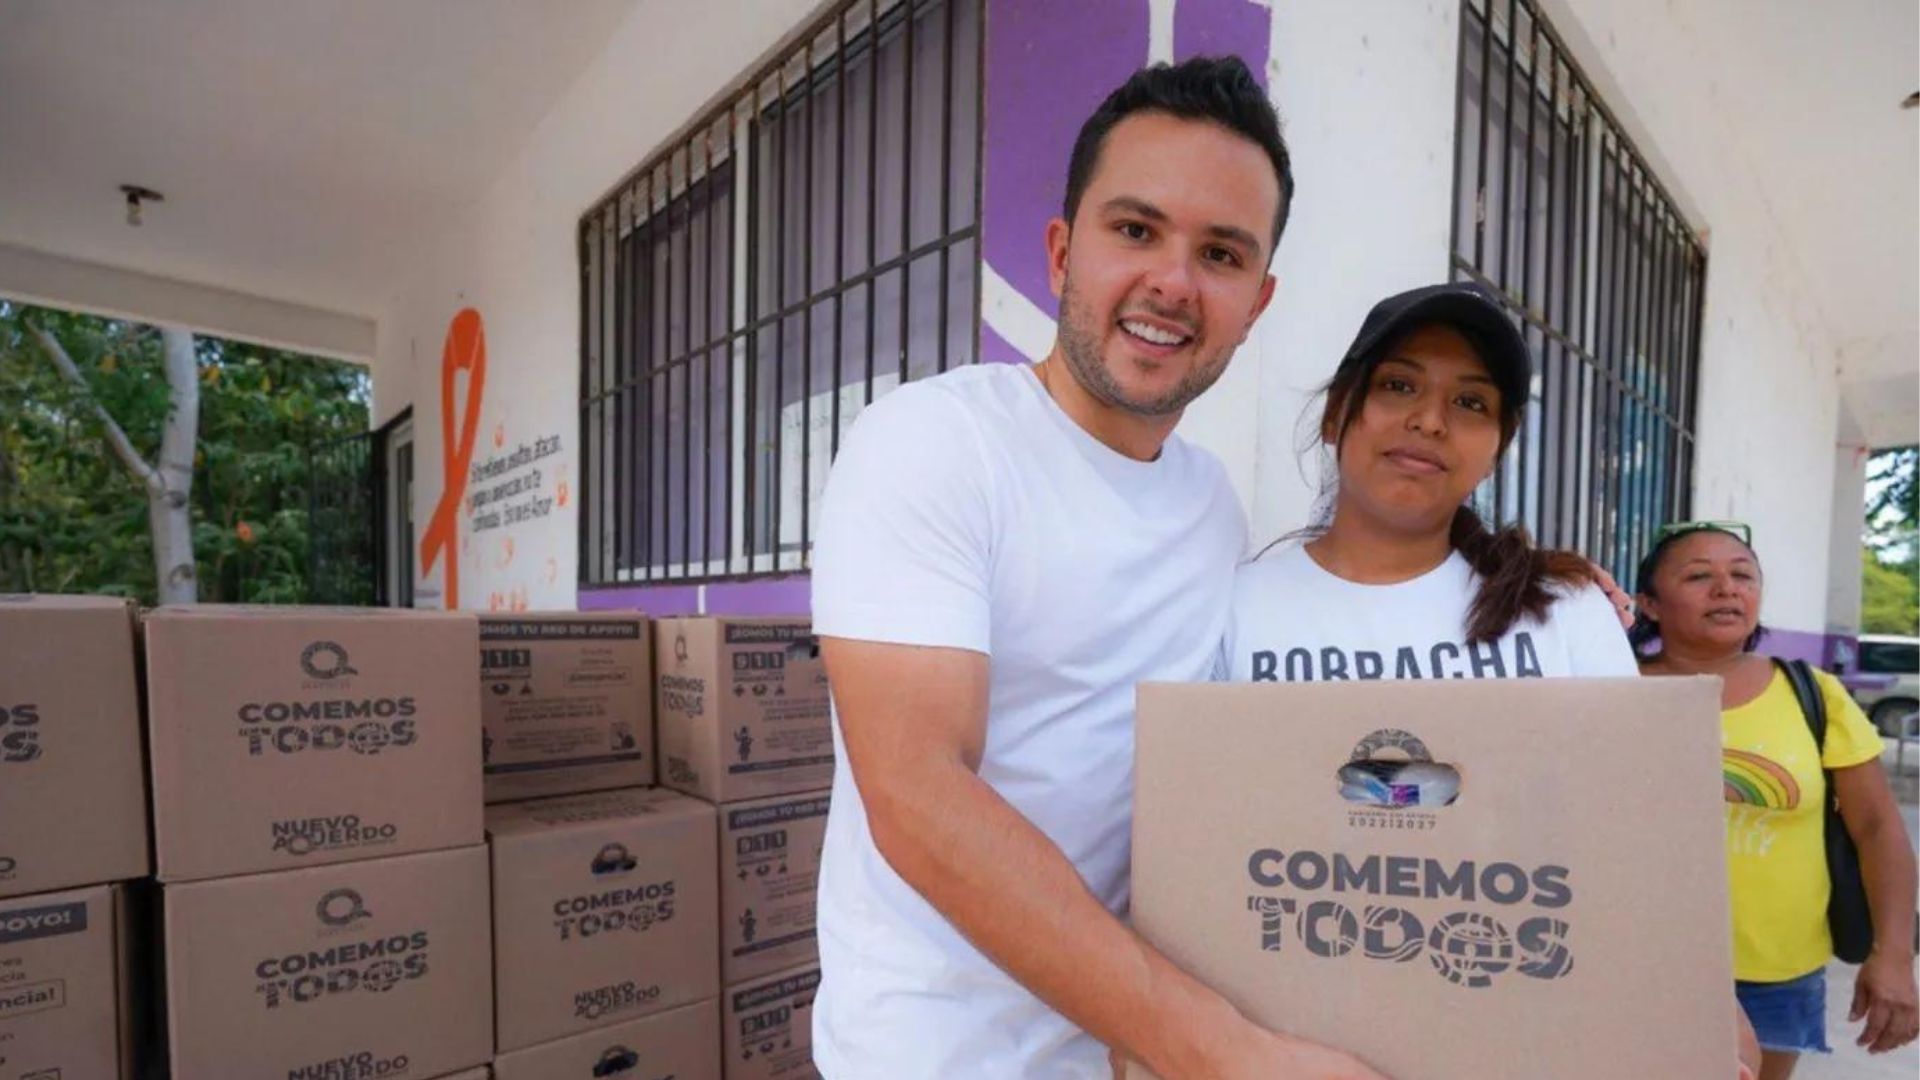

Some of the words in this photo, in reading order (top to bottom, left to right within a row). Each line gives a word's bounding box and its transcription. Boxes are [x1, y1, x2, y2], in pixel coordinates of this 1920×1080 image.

[480, 650, 528, 667] 11
[238, 697, 417, 724] COMEMOS
[271, 814, 360, 838] NUEVO
[1248, 848, 1573, 909] COMEMOS
[553, 881, 675, 917] COMEMOS
[0, 910, 73, 932] OYO!
[256, 931, 429, 979] COMEMOS
